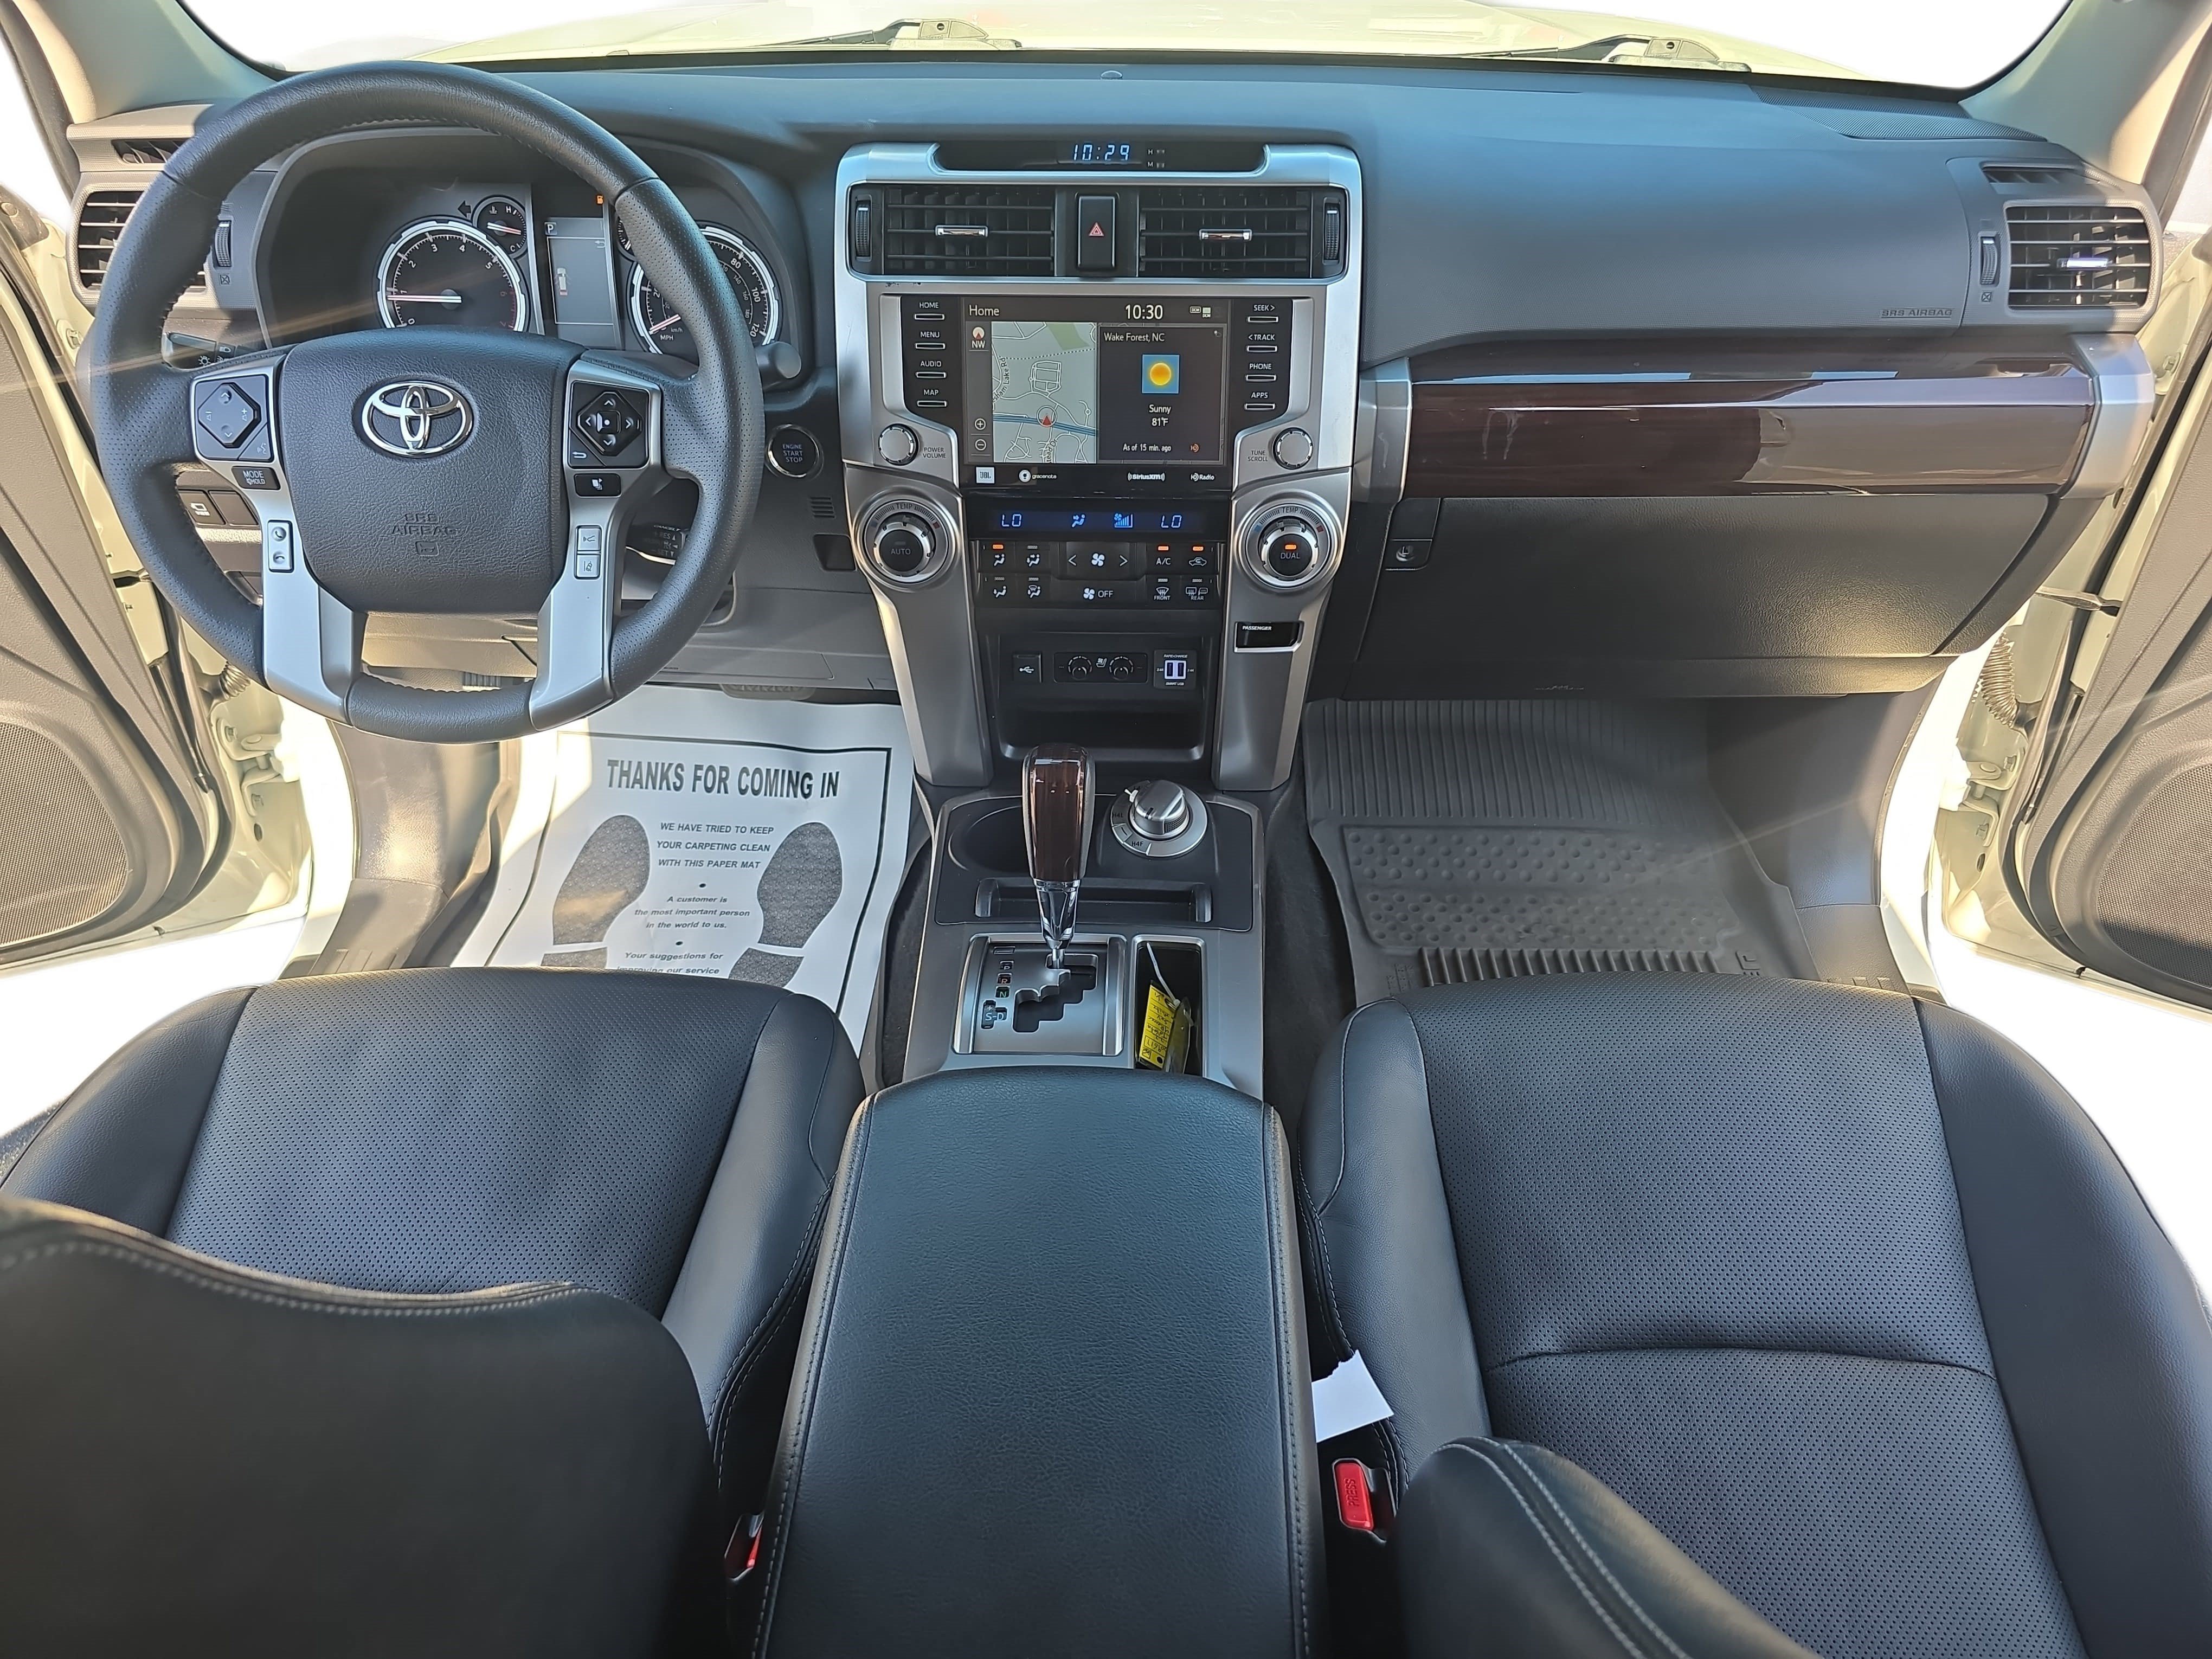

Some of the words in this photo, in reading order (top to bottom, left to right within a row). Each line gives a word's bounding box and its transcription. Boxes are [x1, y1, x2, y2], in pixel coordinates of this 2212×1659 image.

[1073, 144, 1130, 161] 10:29
[547, 224, 554, 234] P
[408, 260, 416, 268] 2
[485, 261, 492, 269] 5
[730, 258, 741, 269] 80
[732, 275, 742, 285] 140
[751, 287, 761, 303] 100
[968, 304, 1000, 317] Home
[1124, 304, 1163, 320] 10:30
[750, 323, 760, 337] 120
[1103, 332, 1124, 341] Wake
[1126, 332, 1151, 343] Forest,
[1152, 332, 1166, 342] NC
[971, 340, 986, 349] NW
[999, 357, 1007, 369] Rd
[1149, 404, 1172, 414] Sunny
[1148, 443, 1161, 452] min.
[1161, 445, 1172, 453] ago
[242, 470, 265, 478] MODE
[896, 503, 913, 511] TEMP
[1156, 557, 1172, 566] A/C
[607, 760, 685, 792] THANKS
[692, 764, 730, 794] FOR
[738, 766, 814, 800] COMING
[820, 771, 840, 799] IN
[660, 822, 676, 831] WE
[677, 823, 703, 832] HAVE
[705, 825, 731, 833] TRIED
[749, 826, 774, 834] KEEP
[657, 841, 682, 849] YOUR
[685, 842, 737, 851] CARPETING
[740, 844, 771, 852] CLEAN
[707, 860, 738, 868] PAPER
[675, 909, 717, 917] important
[649, 953, 706, 961] suggestions
[1345, 1478, 1360, 1507] PRESS
